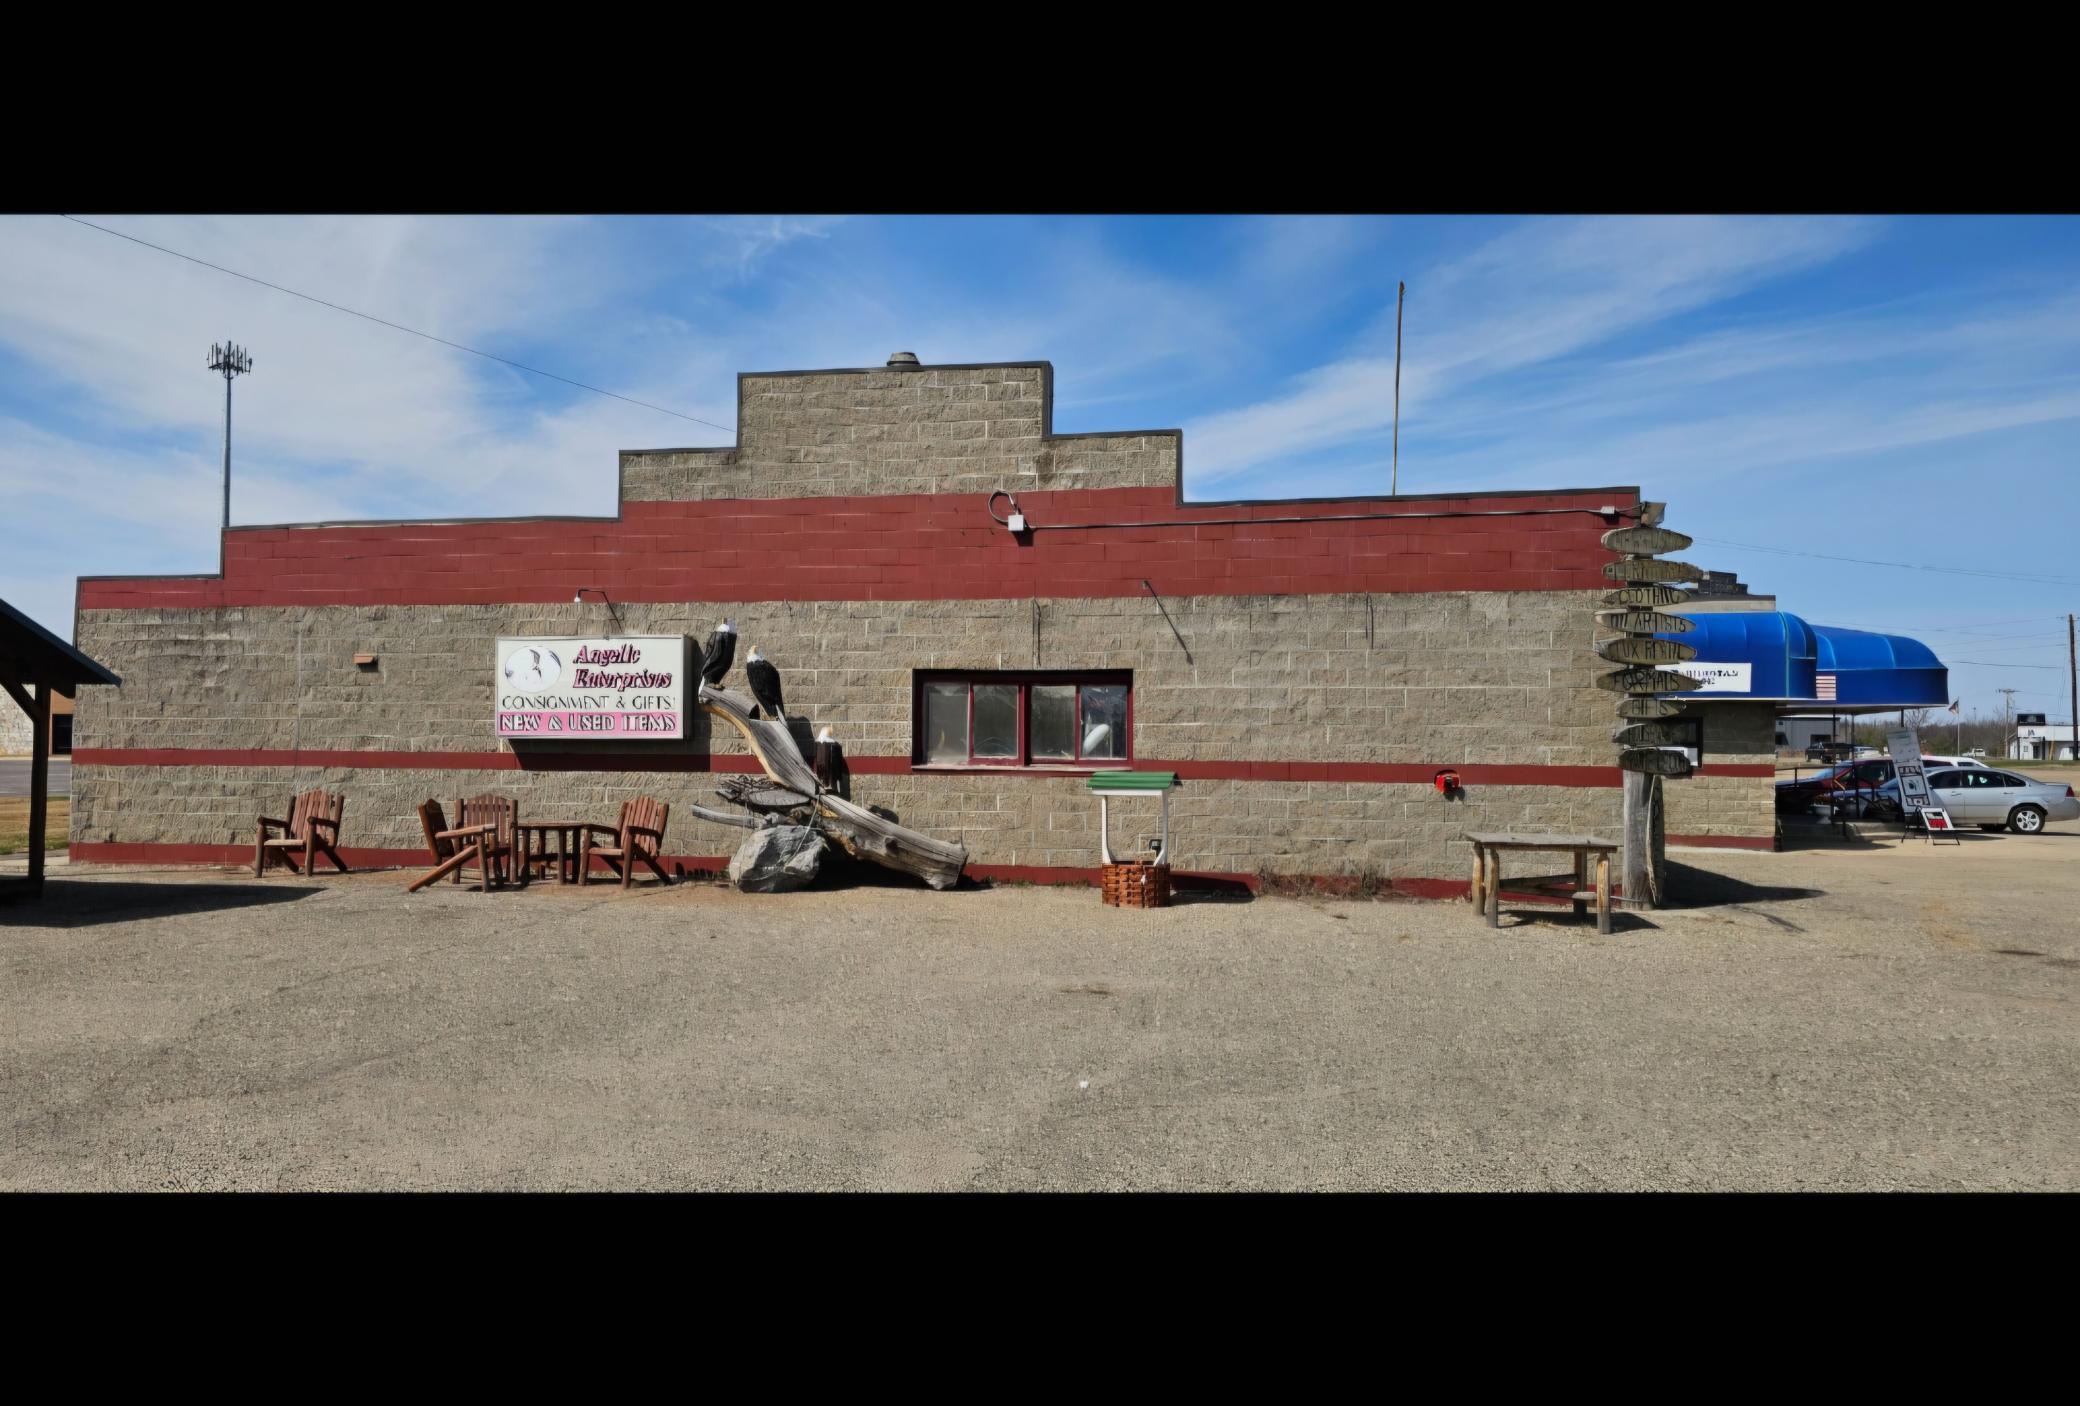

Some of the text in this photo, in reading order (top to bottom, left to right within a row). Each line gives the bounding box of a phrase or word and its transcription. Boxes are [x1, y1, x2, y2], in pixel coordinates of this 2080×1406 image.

[1619, 588, 1680, 606] CLOTHING
[1634, 612, 1686, 633] ARTISTS
[502, 695, 610, 710] CONSIGNMENT
[615, 695, 627, 709] &
[500, 713, 676, 731] NEW & USED ITEMS
